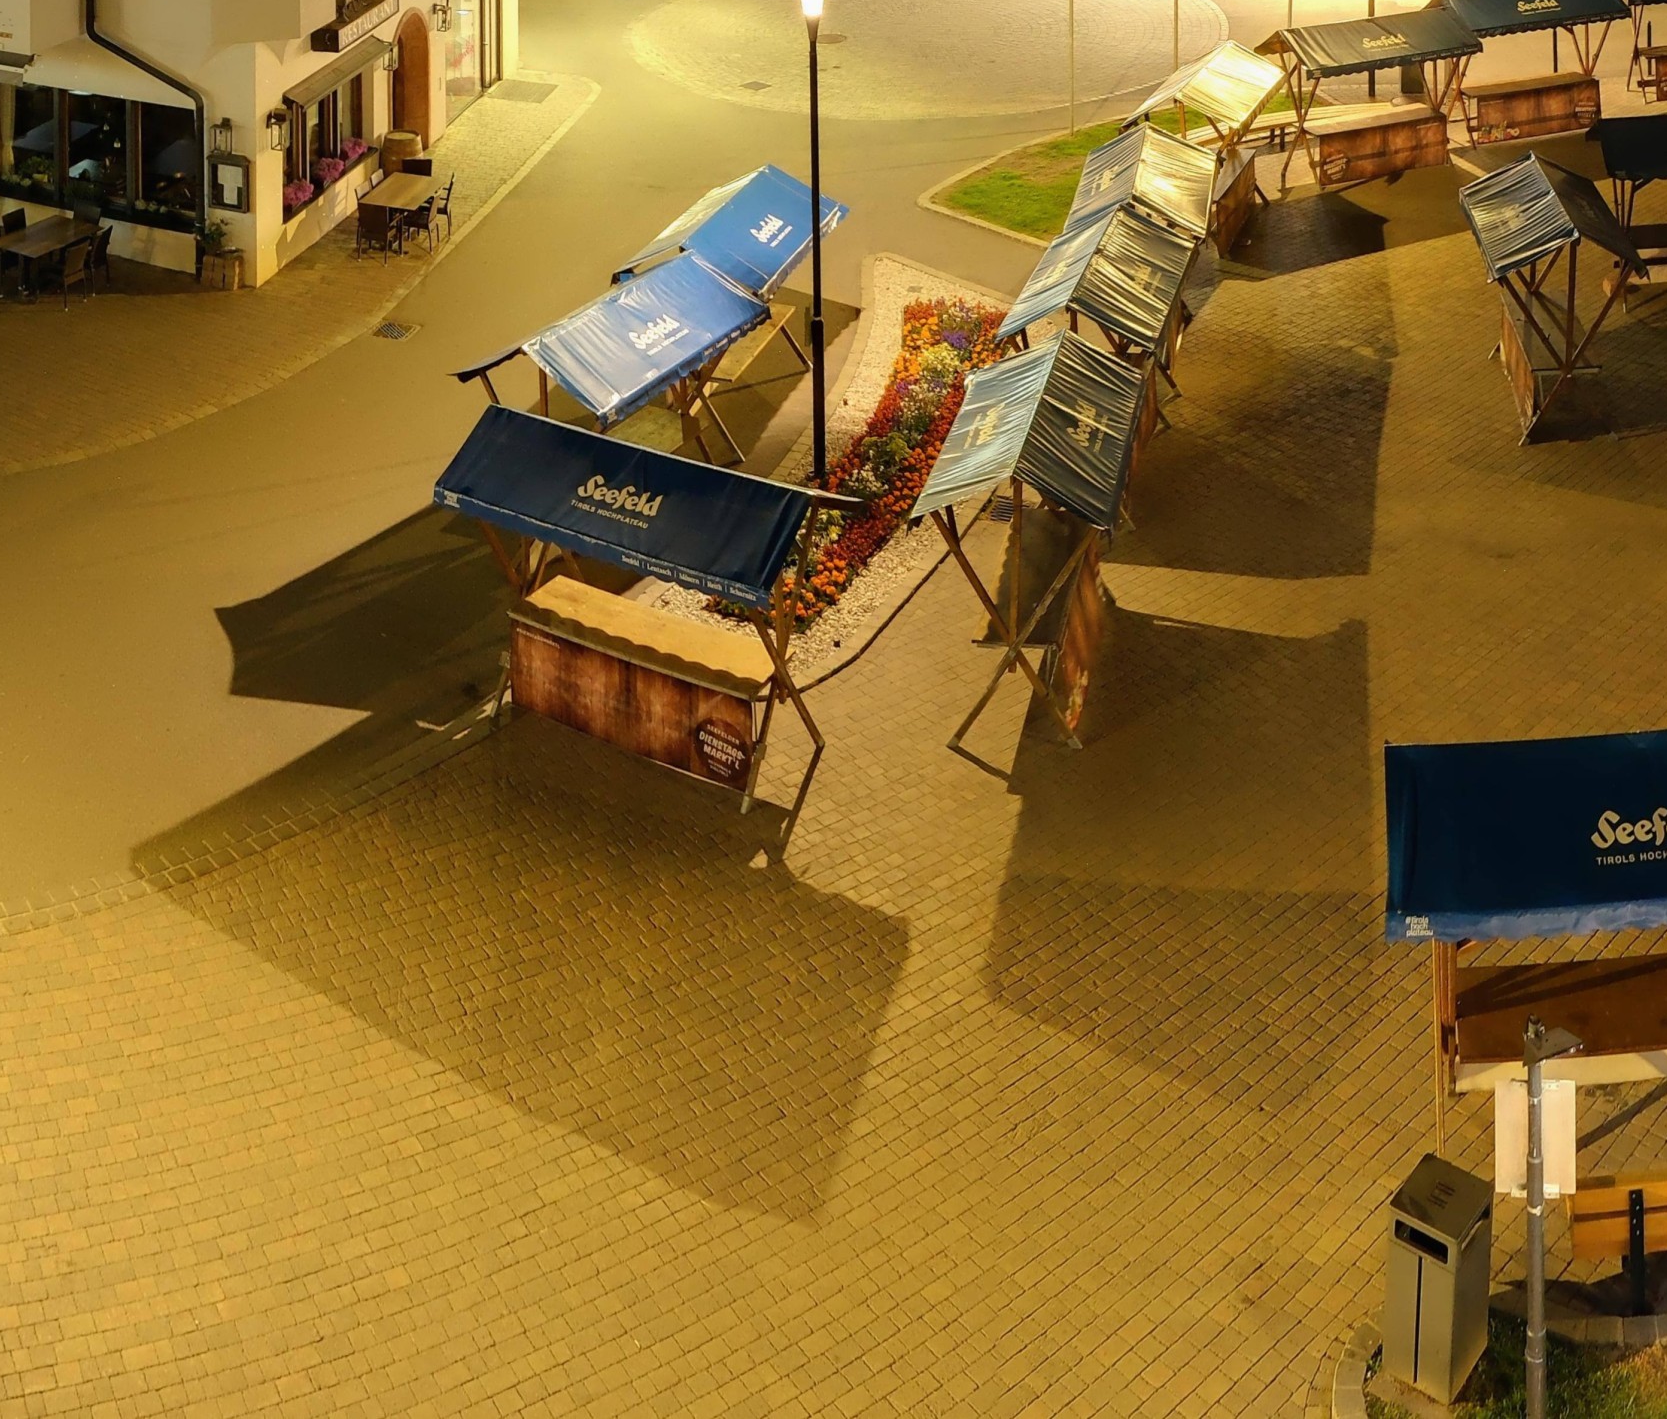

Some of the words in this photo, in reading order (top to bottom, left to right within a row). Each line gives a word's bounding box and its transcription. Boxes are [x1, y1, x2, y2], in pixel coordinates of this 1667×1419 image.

[1362, 33, 1406, 48] Seefeld
[577, 474, 664, 517] Seefeld
[571, 499, 596, 514] TIROLS
[1596, 854, 1636, 866] TIROLS
[1406, 928, 1434, 938] plateau
